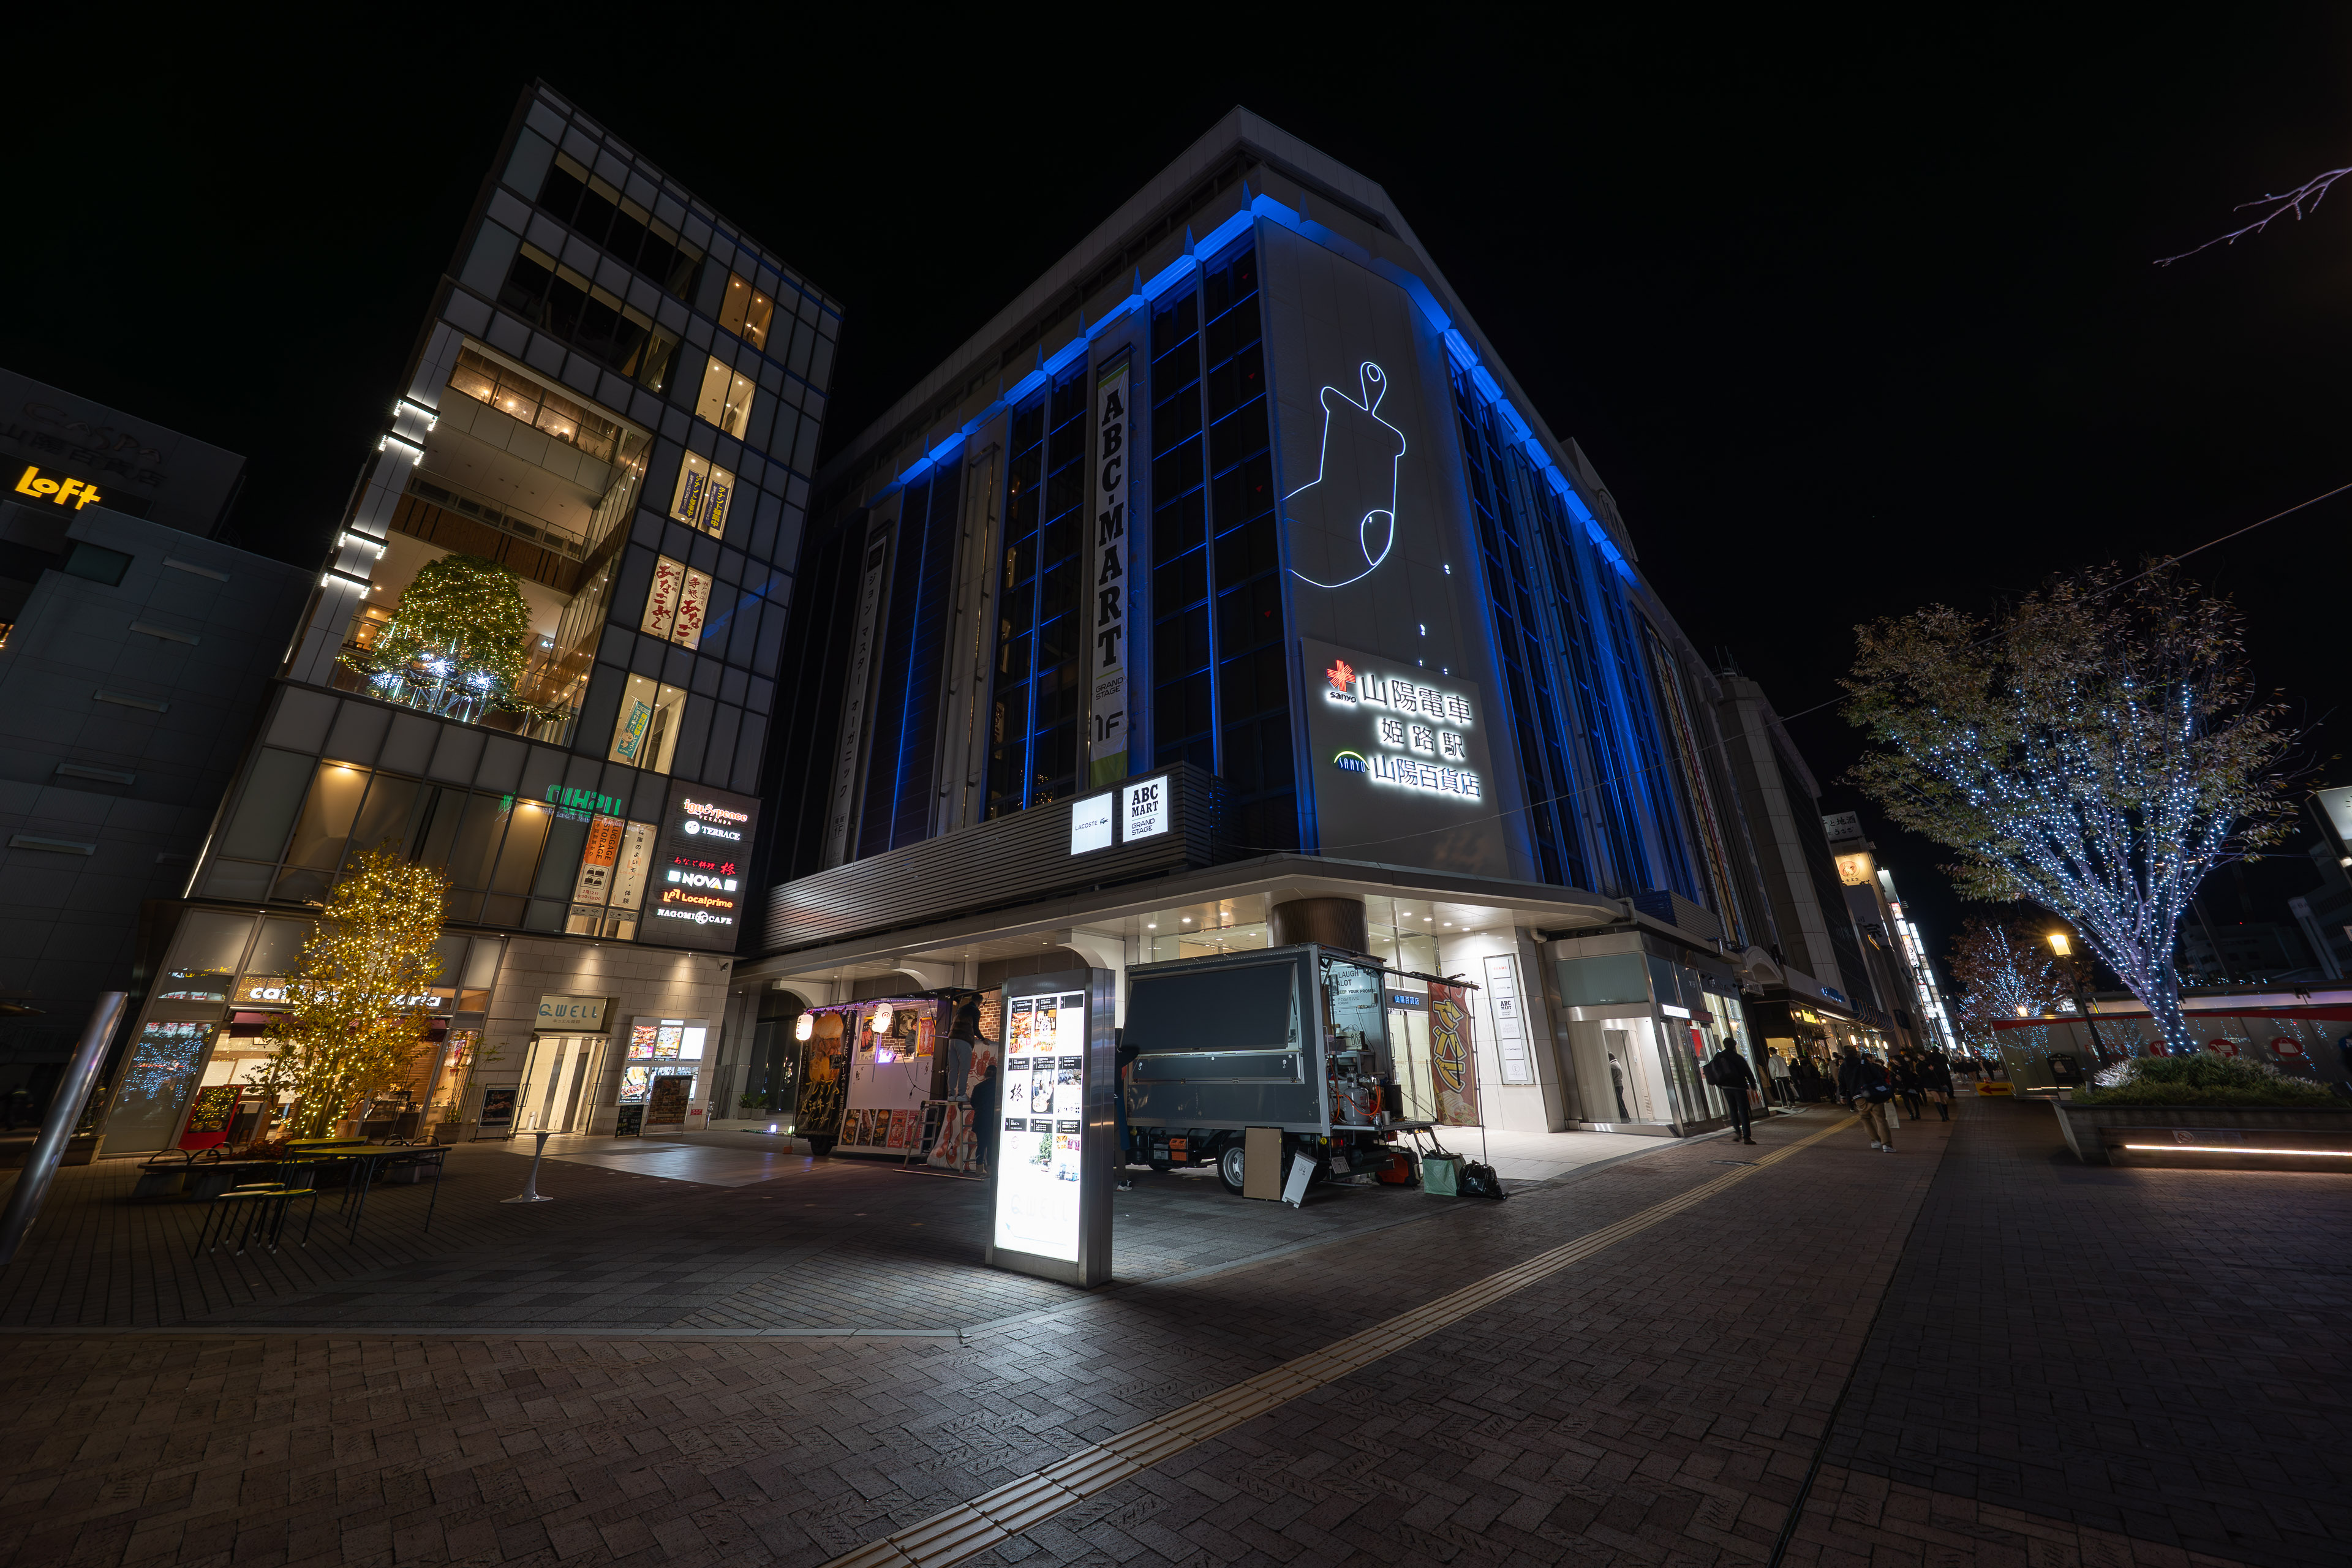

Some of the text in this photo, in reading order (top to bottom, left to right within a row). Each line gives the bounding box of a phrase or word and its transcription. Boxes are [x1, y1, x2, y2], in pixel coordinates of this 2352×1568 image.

[22, 402, 162, 464] CASPA
[1095, 677, 1123, 693] GRAND
[1095, 685, 1121, 701] STAGE
[1330, 691, 1357, 703] sanyo
[1360, 674, 1472, 723] 山陽電車
[1095, 710, 1123, 742] 1F
[1381, 717, 1466, 758] 姫路駅
[1338, 756, 1366, 773] SANYO
[1373, 755, 1480, 797] 山陽百貨店
[1131, 783, 1159, 806] ABC
[1131, 800, 1159, 818] MART
[699, 814, 732, 826] VERANDA
[1074, 820, 1098, 831] LACOSTE
[1131, 818, 1155, 829] GRAND
[1823, 815, 1856, 827] と地酒
[701, 825, 741, 841] TERRACE
[834, 824, 843, 837] 1F
[1131, 825, 1153, 835] STAGE
[595, 823, 611, 859] STORAGE
[605, 824, 620, 861] LUGGAGE
[622, 829, 644, 905] 兵庫のよいモノ・体験
[674, 856, 716, 871] あなご料理
[681, 872, 723, 890] NOVA
[681, 892, 733, 908] Localprime
[657, 908, 733, 925] NAGOMI CAFE
[1338, 970, 1359, 978] LAUGH
[1394, 995, 1420, 1005] 山陽百貨店
